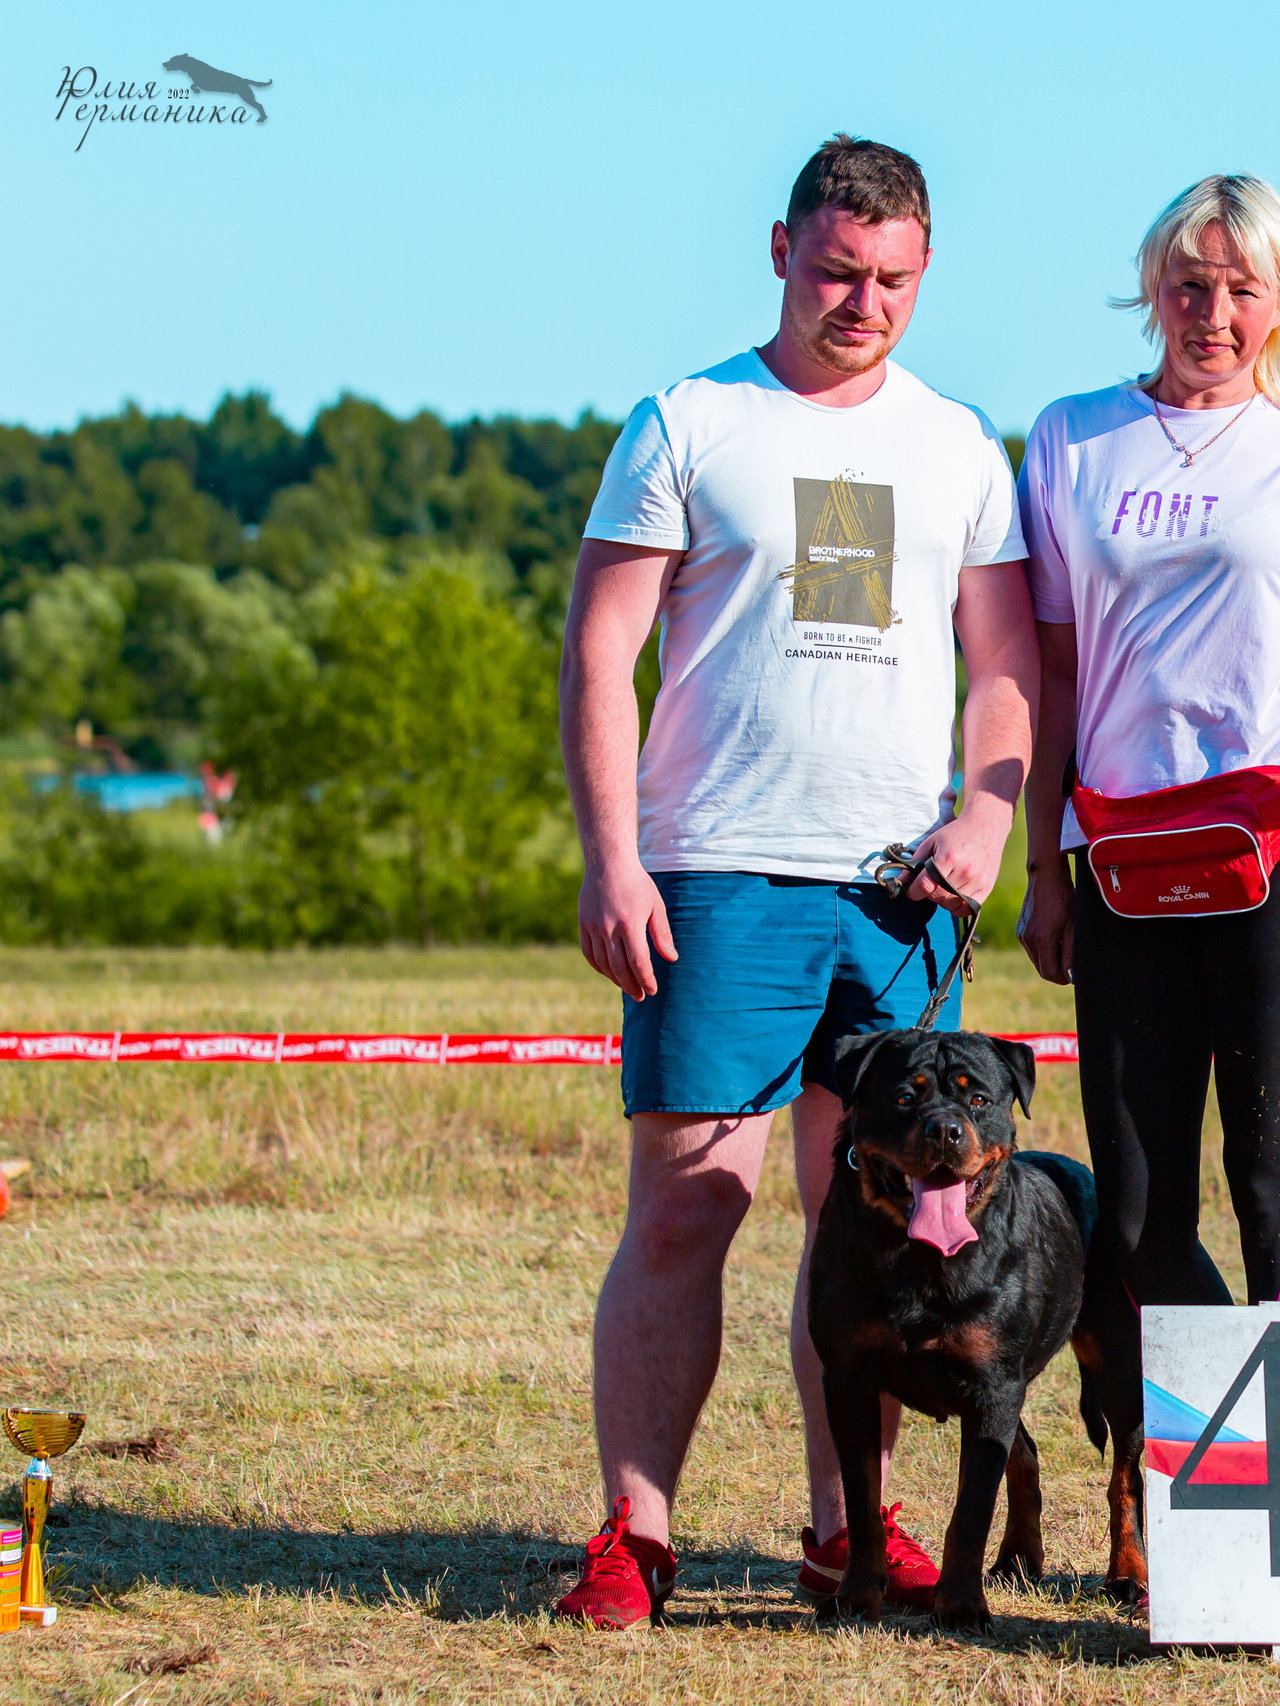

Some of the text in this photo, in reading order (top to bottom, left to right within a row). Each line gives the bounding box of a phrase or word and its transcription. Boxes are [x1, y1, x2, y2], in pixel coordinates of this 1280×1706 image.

[1111, 490, 1219, 538] FONT
[808, 545, 876, 558] BROTHERHOOD
[803, 631, 823, 642] BORN
[826, 632, 835, 642] TO
[837, 633, 846, 643] BE
[855, 635, 882, 647] FIGHTER
[785, 648, 899, 666] CANADIAN HERITAGE
[1158, 892, 1210, 903] ROYAL CANIN
[19, 1036, 110, 1058] ТРАПЕЗА
[183, 1036, 276, 1058] ТРАПЕЗА
[348, 1038, 440, 1060] ТРАПЕЗА
[511, 1039, 605, 1061] ТРАПЕЗА
